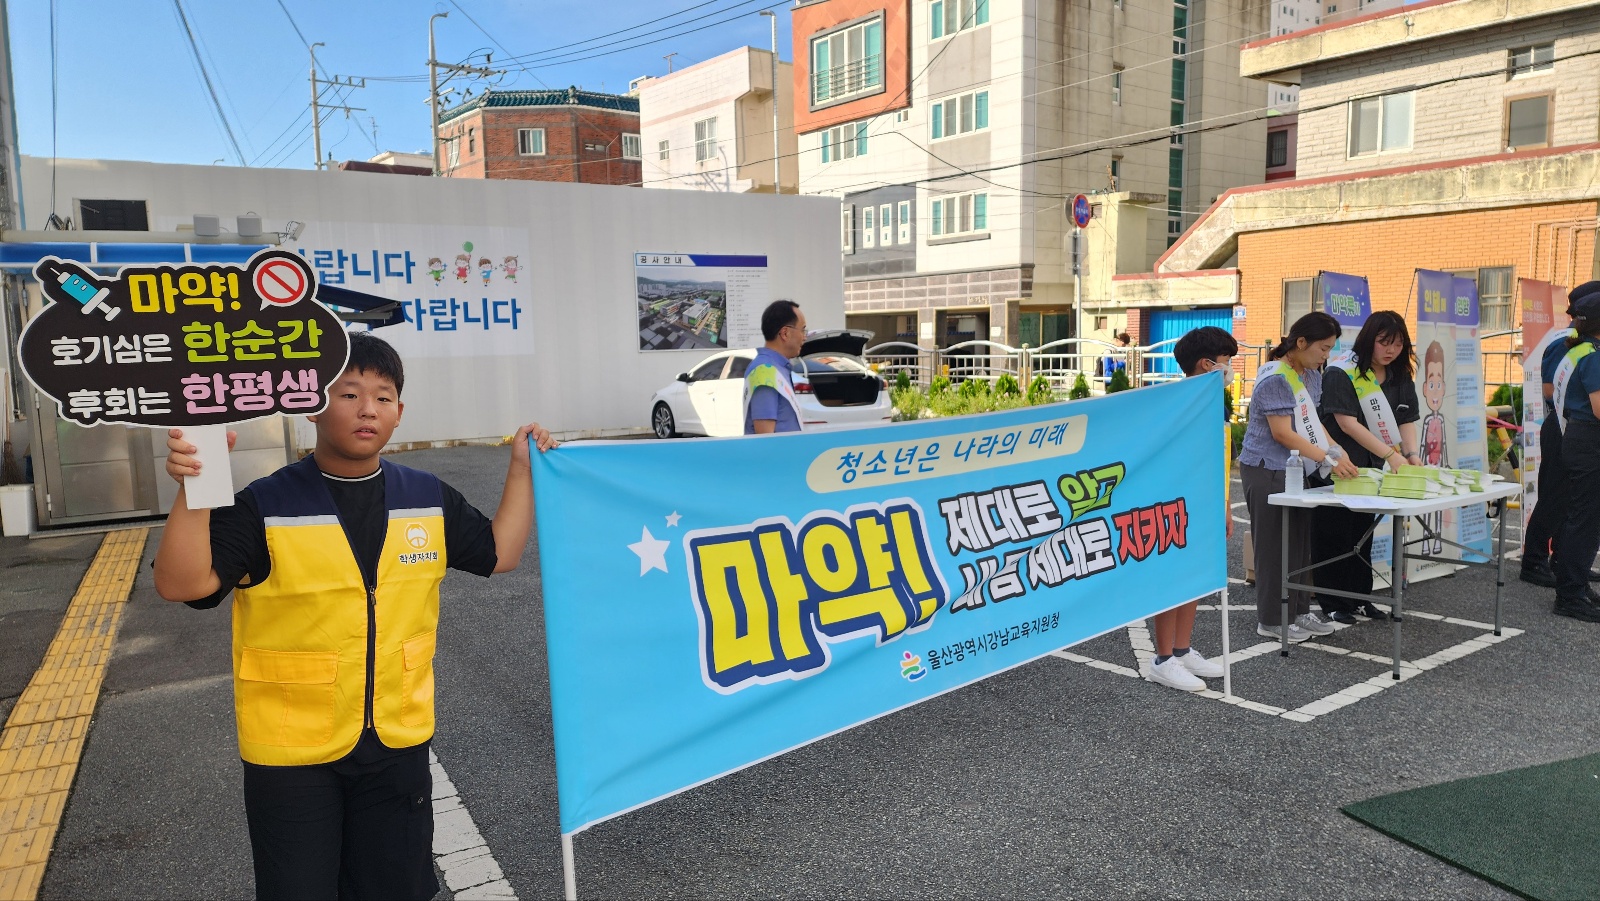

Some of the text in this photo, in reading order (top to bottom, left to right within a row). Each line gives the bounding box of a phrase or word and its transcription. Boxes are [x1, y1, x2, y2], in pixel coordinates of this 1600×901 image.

[128, 272, 240, 314] 마약!
[401, 298, 522, 331] 자랍니다
[50, 318, 324, 366] 호기심은 한순간
[67, 368, 320, 418] 후회는 한평생
[1370, 398, 1381, 411] 마약
[836, 422, 1069, 484] 청소년은 나라의 미래
[938, 461, 1126, 555] 제대로 알고
[399, 551, 438, 564] 학생자치회
[1026, 517, 1116, 591] 제대로
[1112, 497, 1188, 565] 지키자
[688, 502, 947, 689] 마약!
[928, 611, 1060, 671] 울산광역시강남교육지원청
